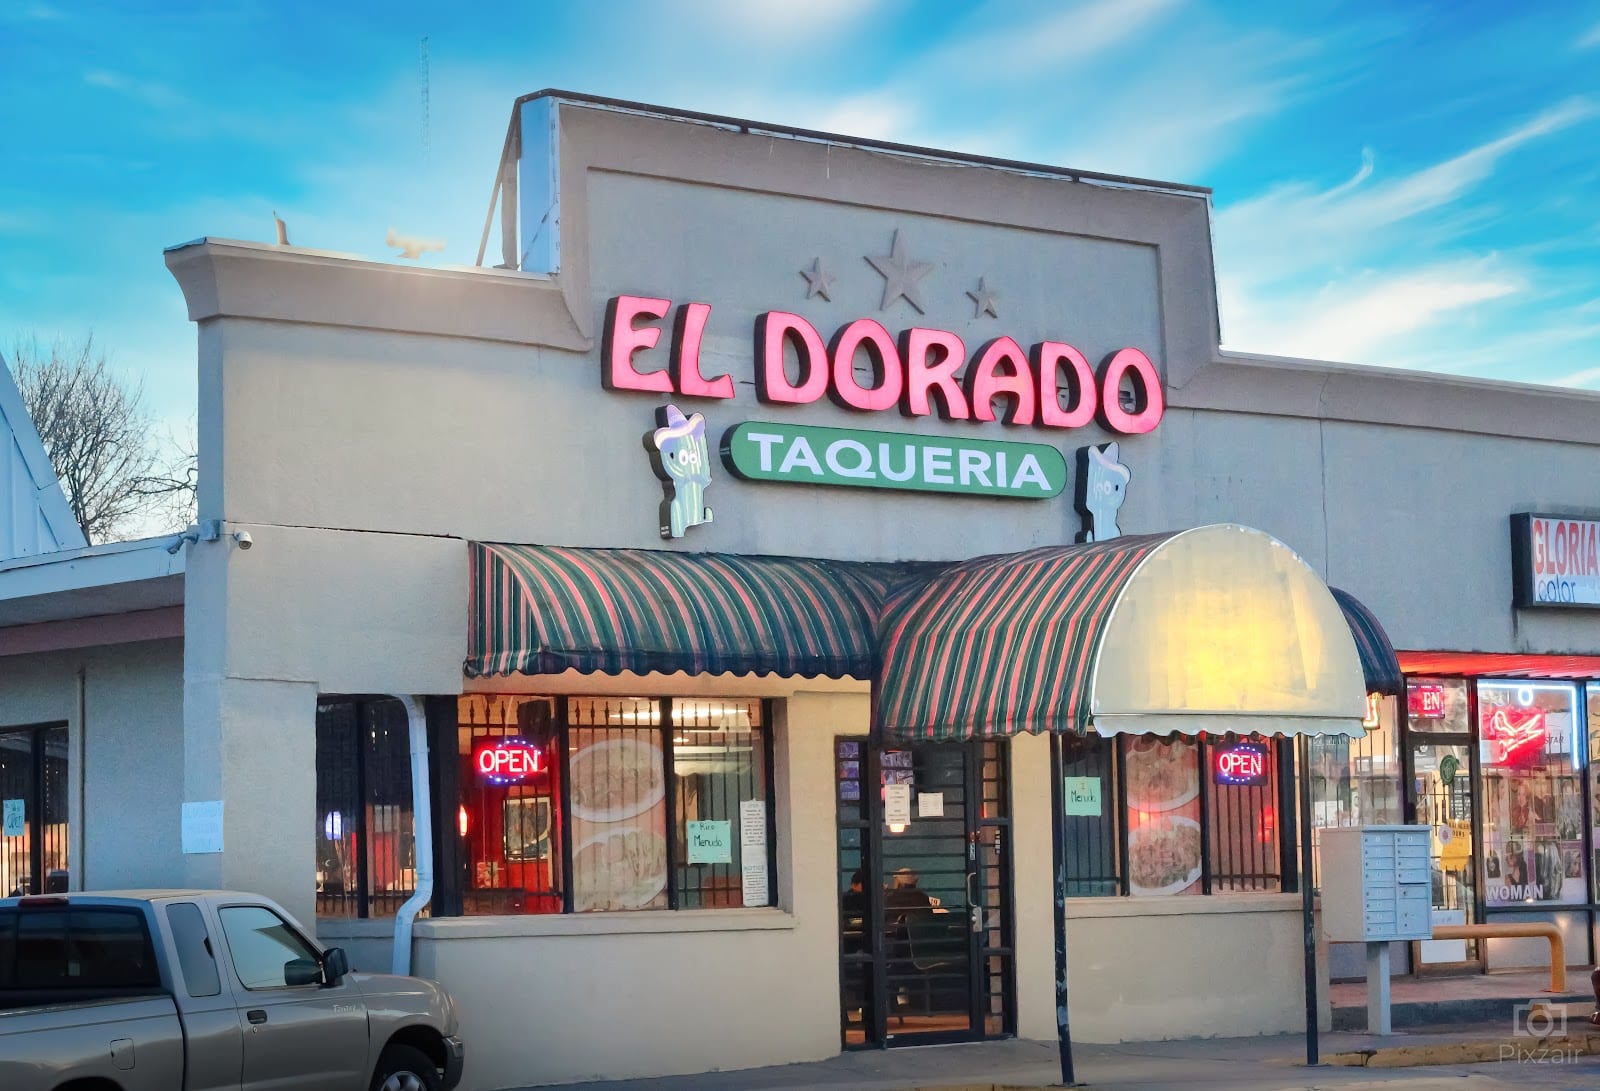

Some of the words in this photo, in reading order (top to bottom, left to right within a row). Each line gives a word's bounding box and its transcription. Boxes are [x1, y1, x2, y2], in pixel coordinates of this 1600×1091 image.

[608, 295, 735, 399] EL
[761, 311, 1165, 434] DORADO
[747, 432, 1051, 491] TAQUERIA
[1534, 519, 1600, 576] GLORIA
[479, 749, 538, 772] OPEN
[1219, 753, 1262, 775] OPEN
[693, 834, 723, 847] Menudo
[1487, 885, 1544, 900] WOMAN
